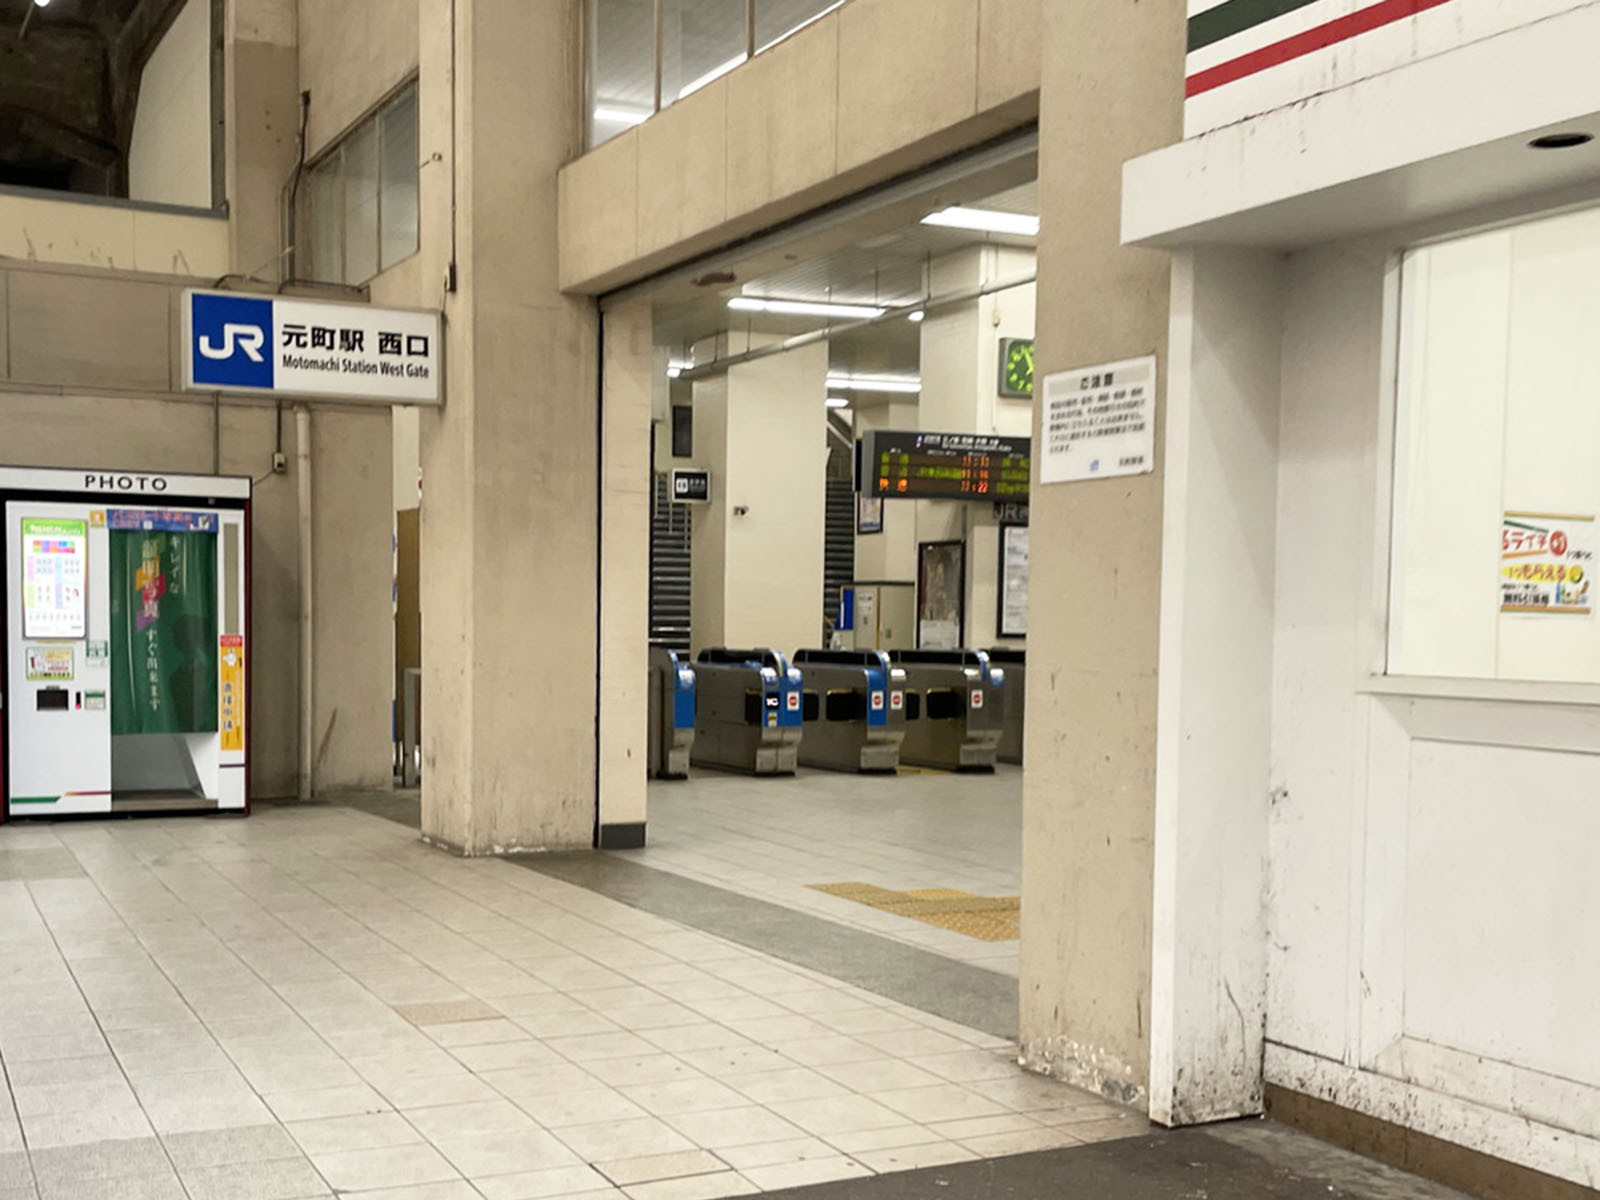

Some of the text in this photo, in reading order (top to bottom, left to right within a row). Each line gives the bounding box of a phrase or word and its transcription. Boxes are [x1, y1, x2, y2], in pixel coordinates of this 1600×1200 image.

[199, 323, 265, 362] JR
[282, 323, 429, 358] 元町駅 西口
[282, 354, 430, 380] Motomachi Station West Gate
[84, 474, 168, 492] PHOTO
